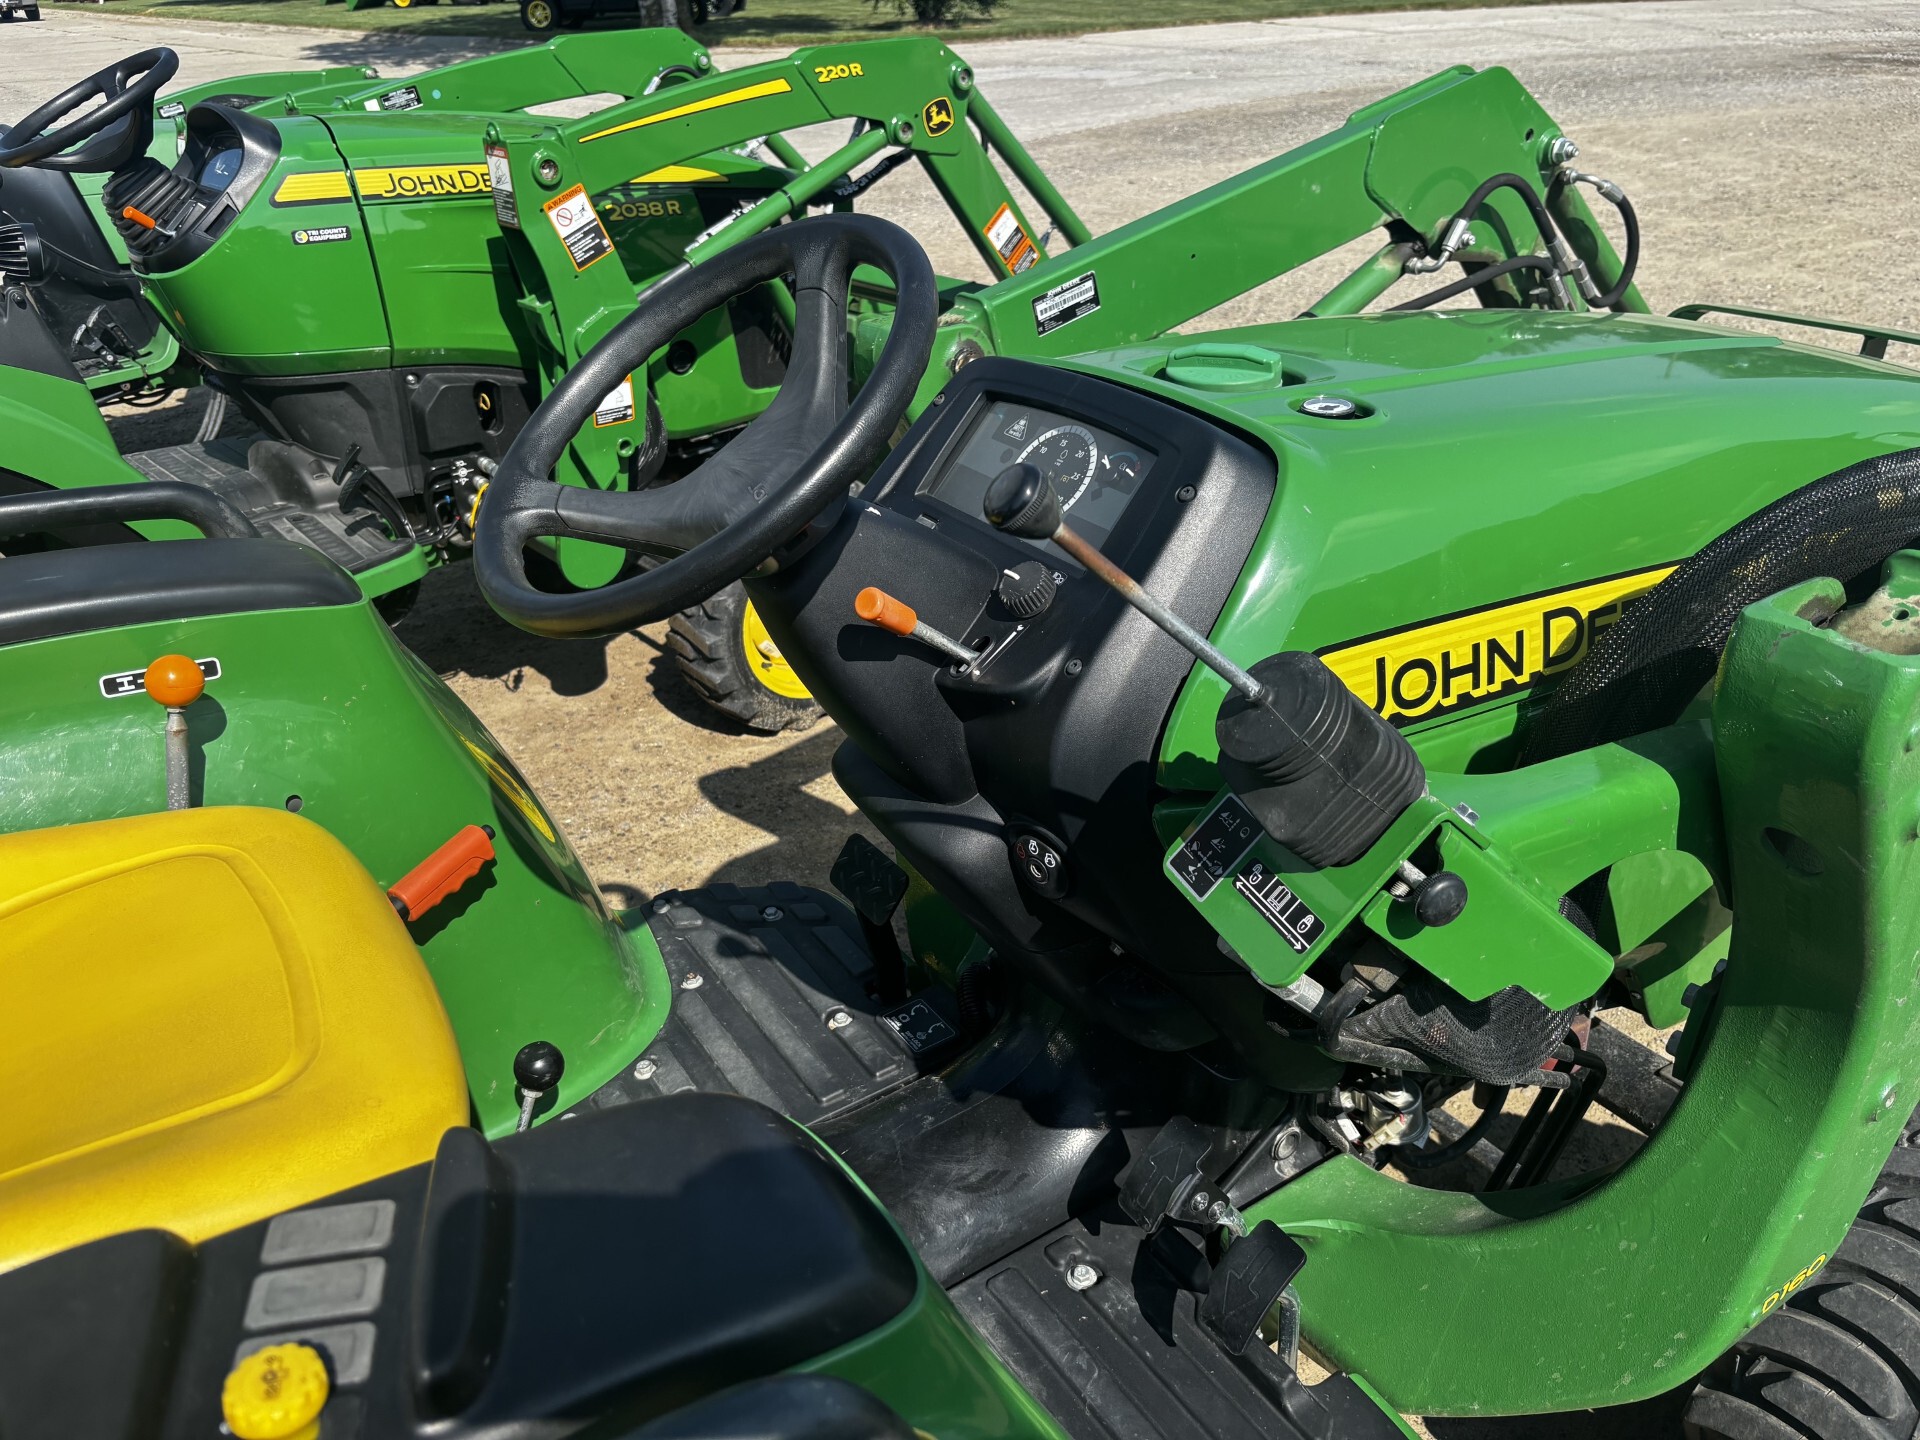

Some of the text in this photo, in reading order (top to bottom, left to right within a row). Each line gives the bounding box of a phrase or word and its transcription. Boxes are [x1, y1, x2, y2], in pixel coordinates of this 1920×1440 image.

[384, 172, 459, 195] JOHN
[551, 186, 582, 208] WARNING
[319, 227, 347, 235] COUNTY
[309, 233, 348, 242] EQUIPMENT
[1059, 439, 1069, 447] 15
[1075, 450, 1085, 459] 20
[1070, 472, 1081, 481] 25
[1370, 629, 1524, 714] JOHN
[1762, 1252, 1827, 1314] D160
